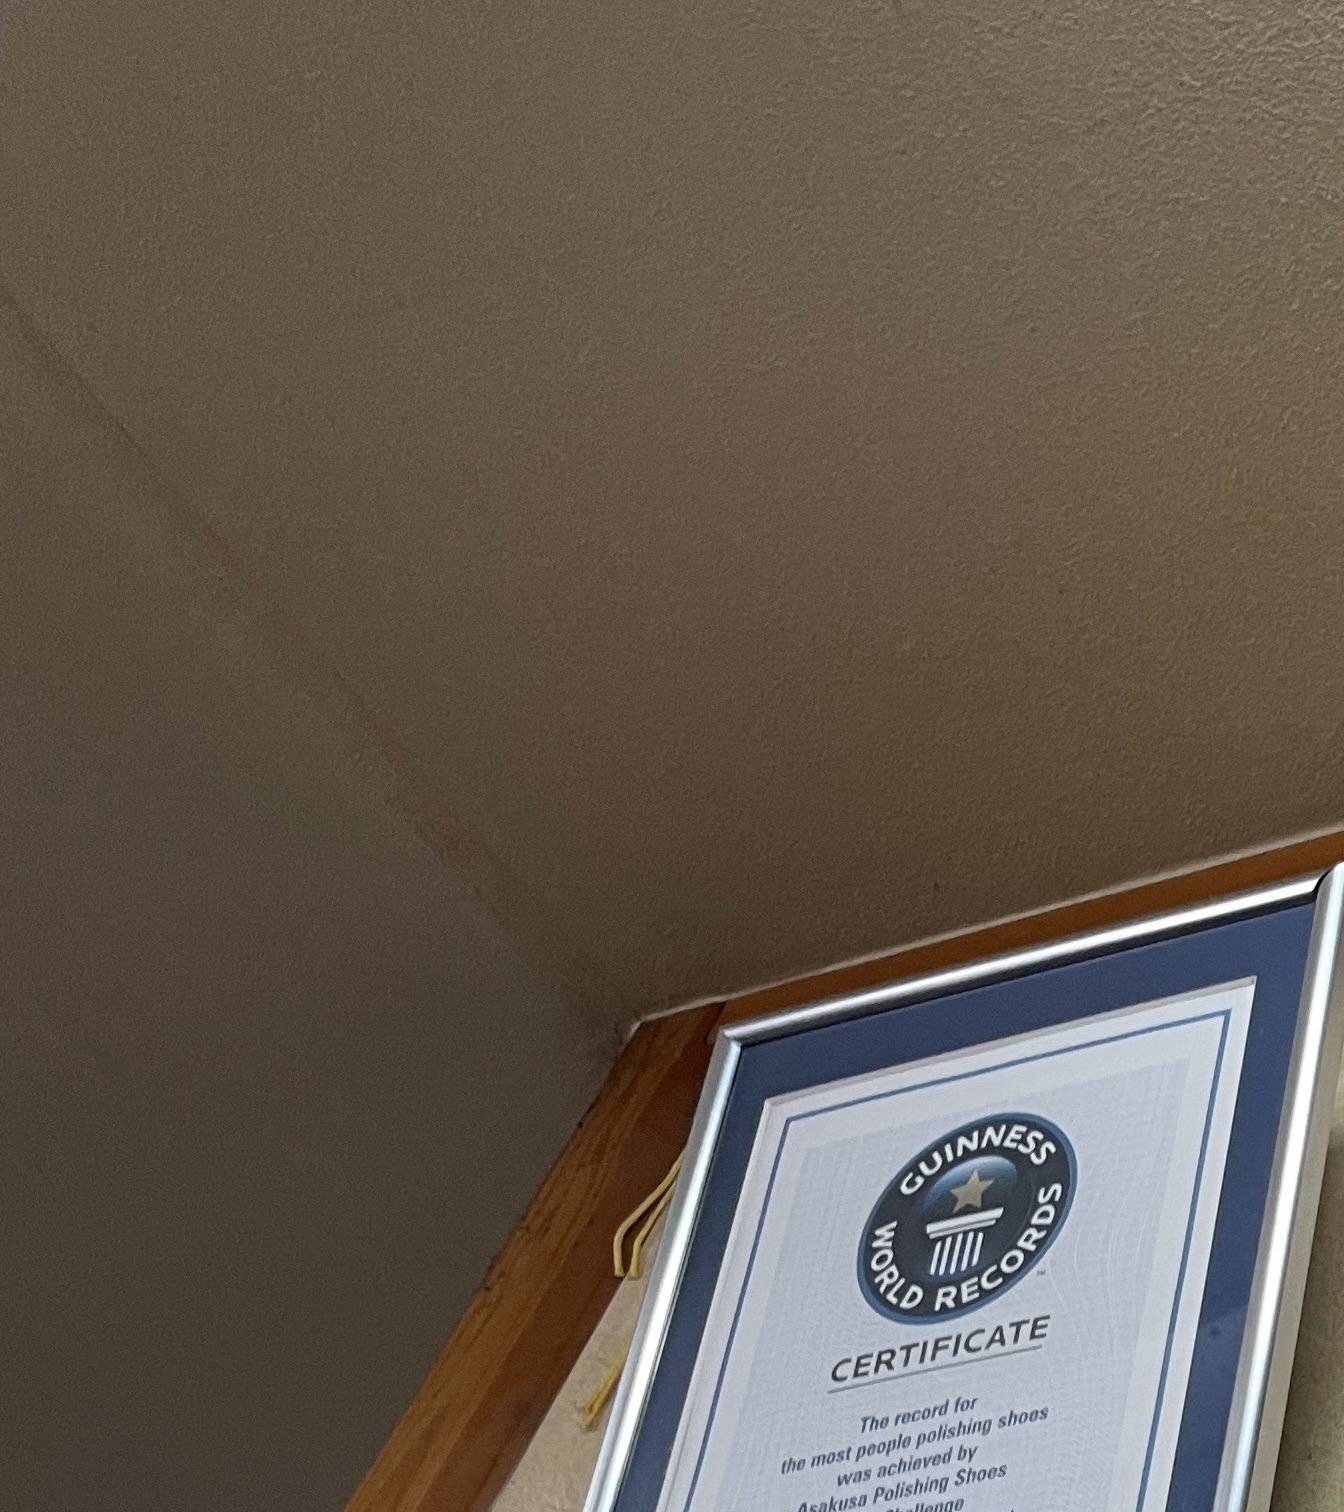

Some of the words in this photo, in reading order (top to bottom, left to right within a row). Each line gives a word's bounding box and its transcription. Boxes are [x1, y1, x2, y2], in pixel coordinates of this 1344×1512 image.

[899, 1122, 1057, 1197] GUINNESS
[870, 1219, 925, 1311] WORLD
[934, 1181, 1064, 1312] RECORDS
[830, 1314, 1052, 1384] CERTIFICATE
[781, 1457, 806, 1475] the
[811, 1446, 852, 1469] most
[855, 1433, 912, 1462] people
[915, 1417, 993, 1450] polishing
[997, 1407, 1049, 1429] shoes
[861, 1415, 890, 1434] The
[894, 1398, 950, 1427] record
[954, 1395, 979, 1414] for
[837, 1468, 872, 1487] was
[877, 1446, 953, 1479] achieved
[957, 1444, 979, 1463] by
[873, 1476, 949, 1505] Polishing
[954, 1464, 1008, 1487] Shoes
